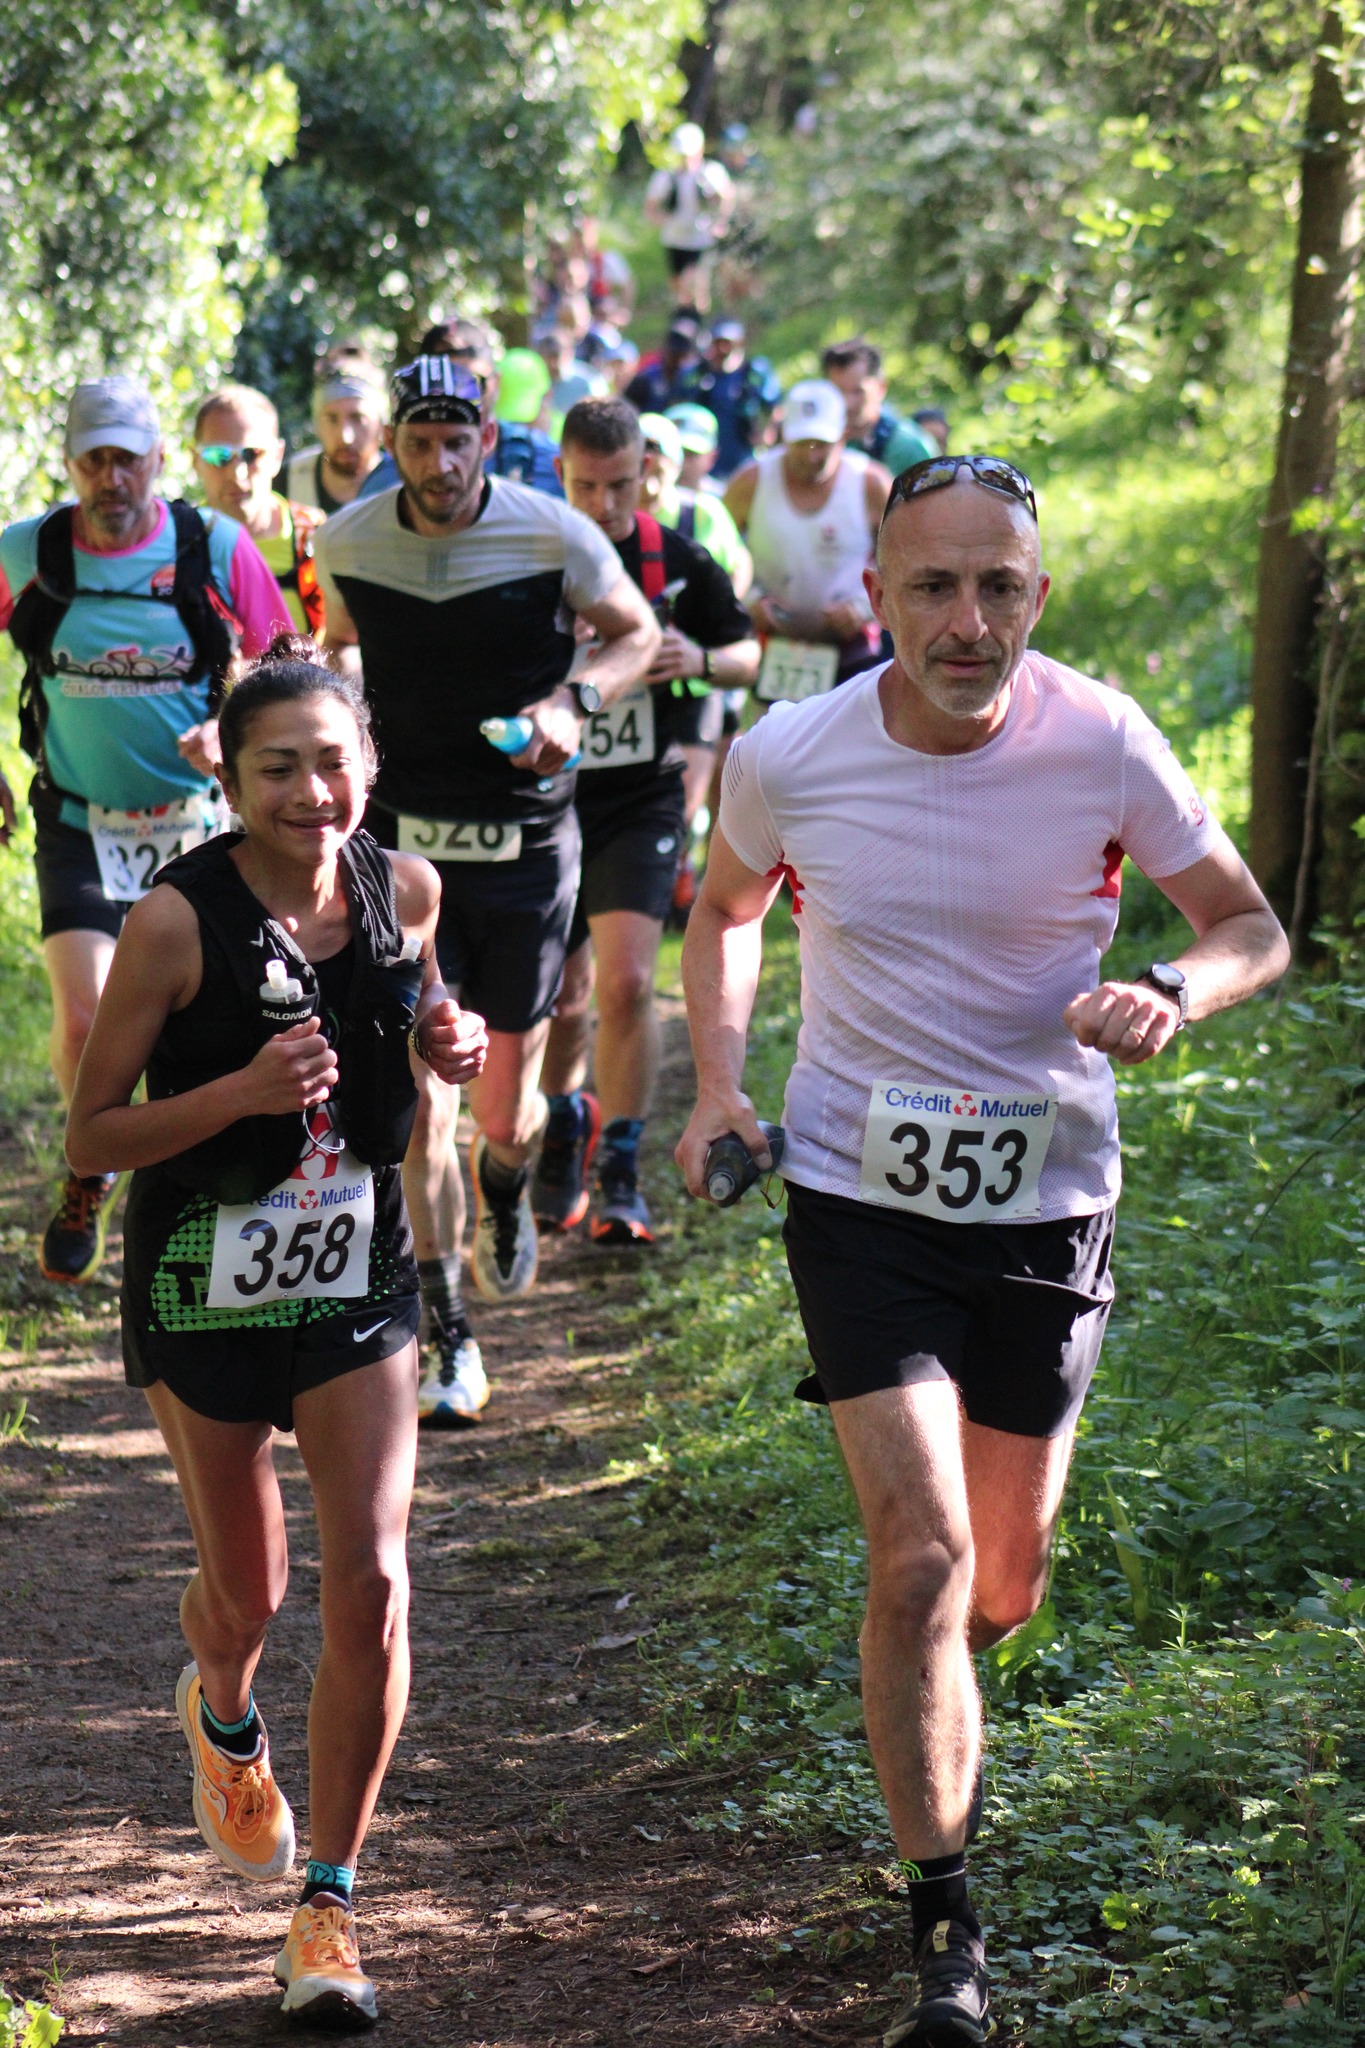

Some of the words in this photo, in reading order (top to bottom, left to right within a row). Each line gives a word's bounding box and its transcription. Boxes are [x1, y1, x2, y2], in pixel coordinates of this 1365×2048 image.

[580, 708, 641, 758] 54
[262, 1007, 312, 1021] SALOMON
[885, 1087, 953, 1115] Crédit
[980, 1099, 1050, 1118] Mutuel
[884, 1121, 1028, 1210] 353
[320, 1180, 367, 1208] Mutuel
[233, 1212, 356, 1296] 358
